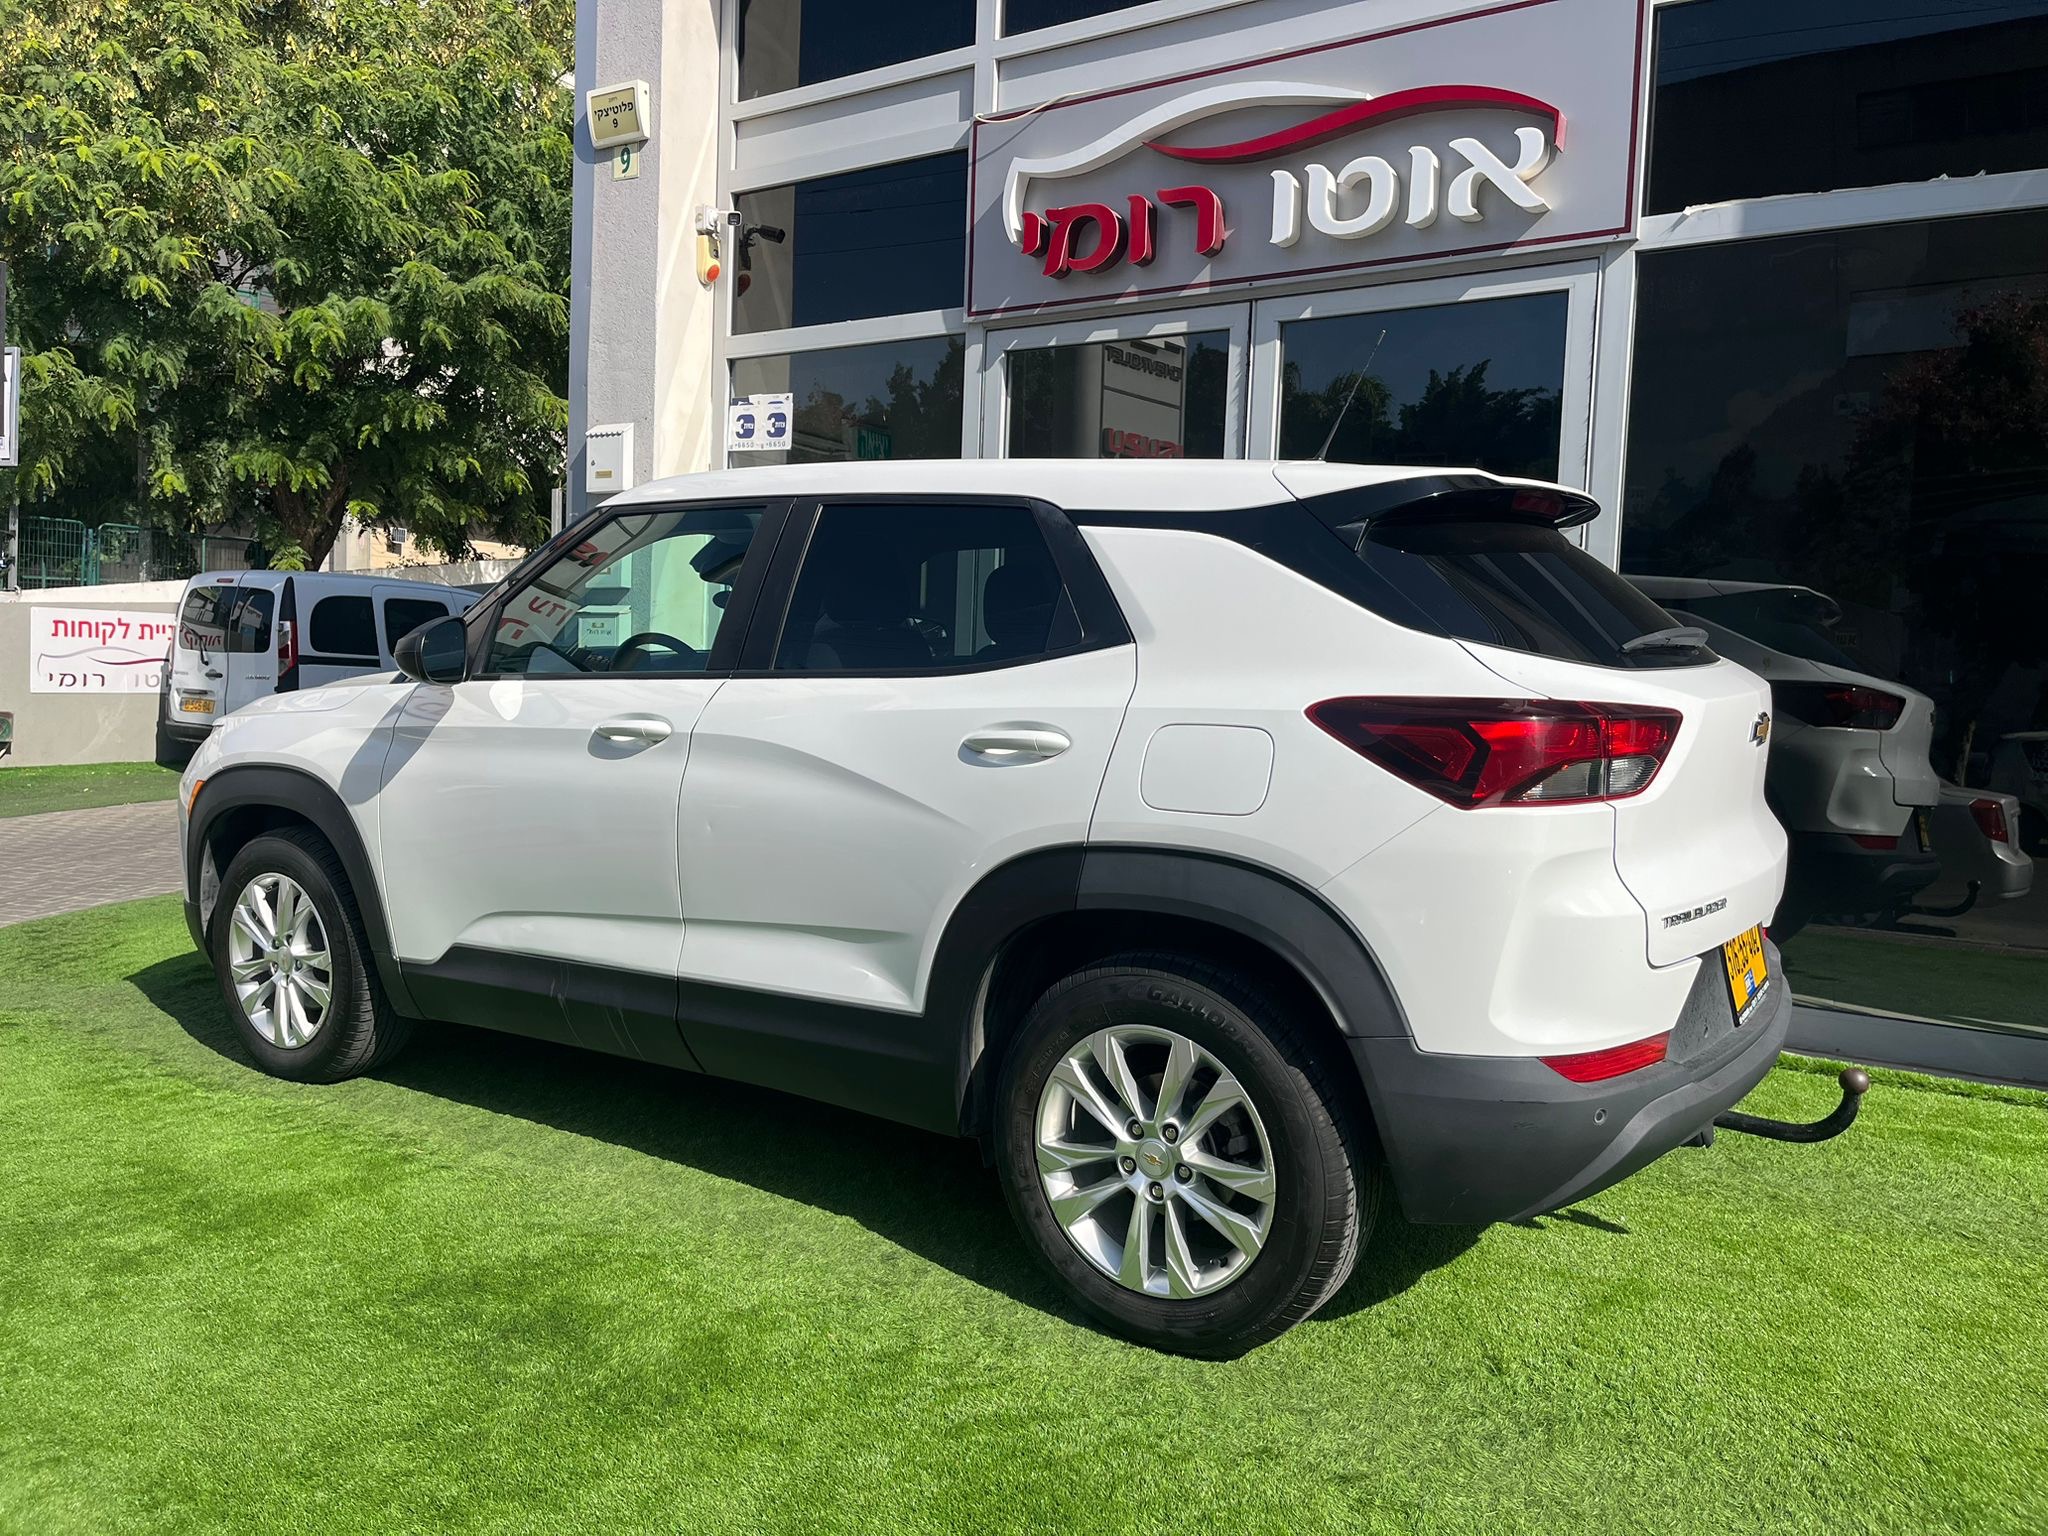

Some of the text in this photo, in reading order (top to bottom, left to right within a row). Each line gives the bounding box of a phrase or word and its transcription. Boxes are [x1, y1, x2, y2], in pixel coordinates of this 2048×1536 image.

[594, 101, 634, 121] פלוטיצקי
[612, 118, 619, 128] 9
[620, 146, 631, 174] 9
[1021, 126, 1552, 279] אוטו רומי
[51, 617, 131, 646] לקוחות
[49, 672, 106, 687] רומי
